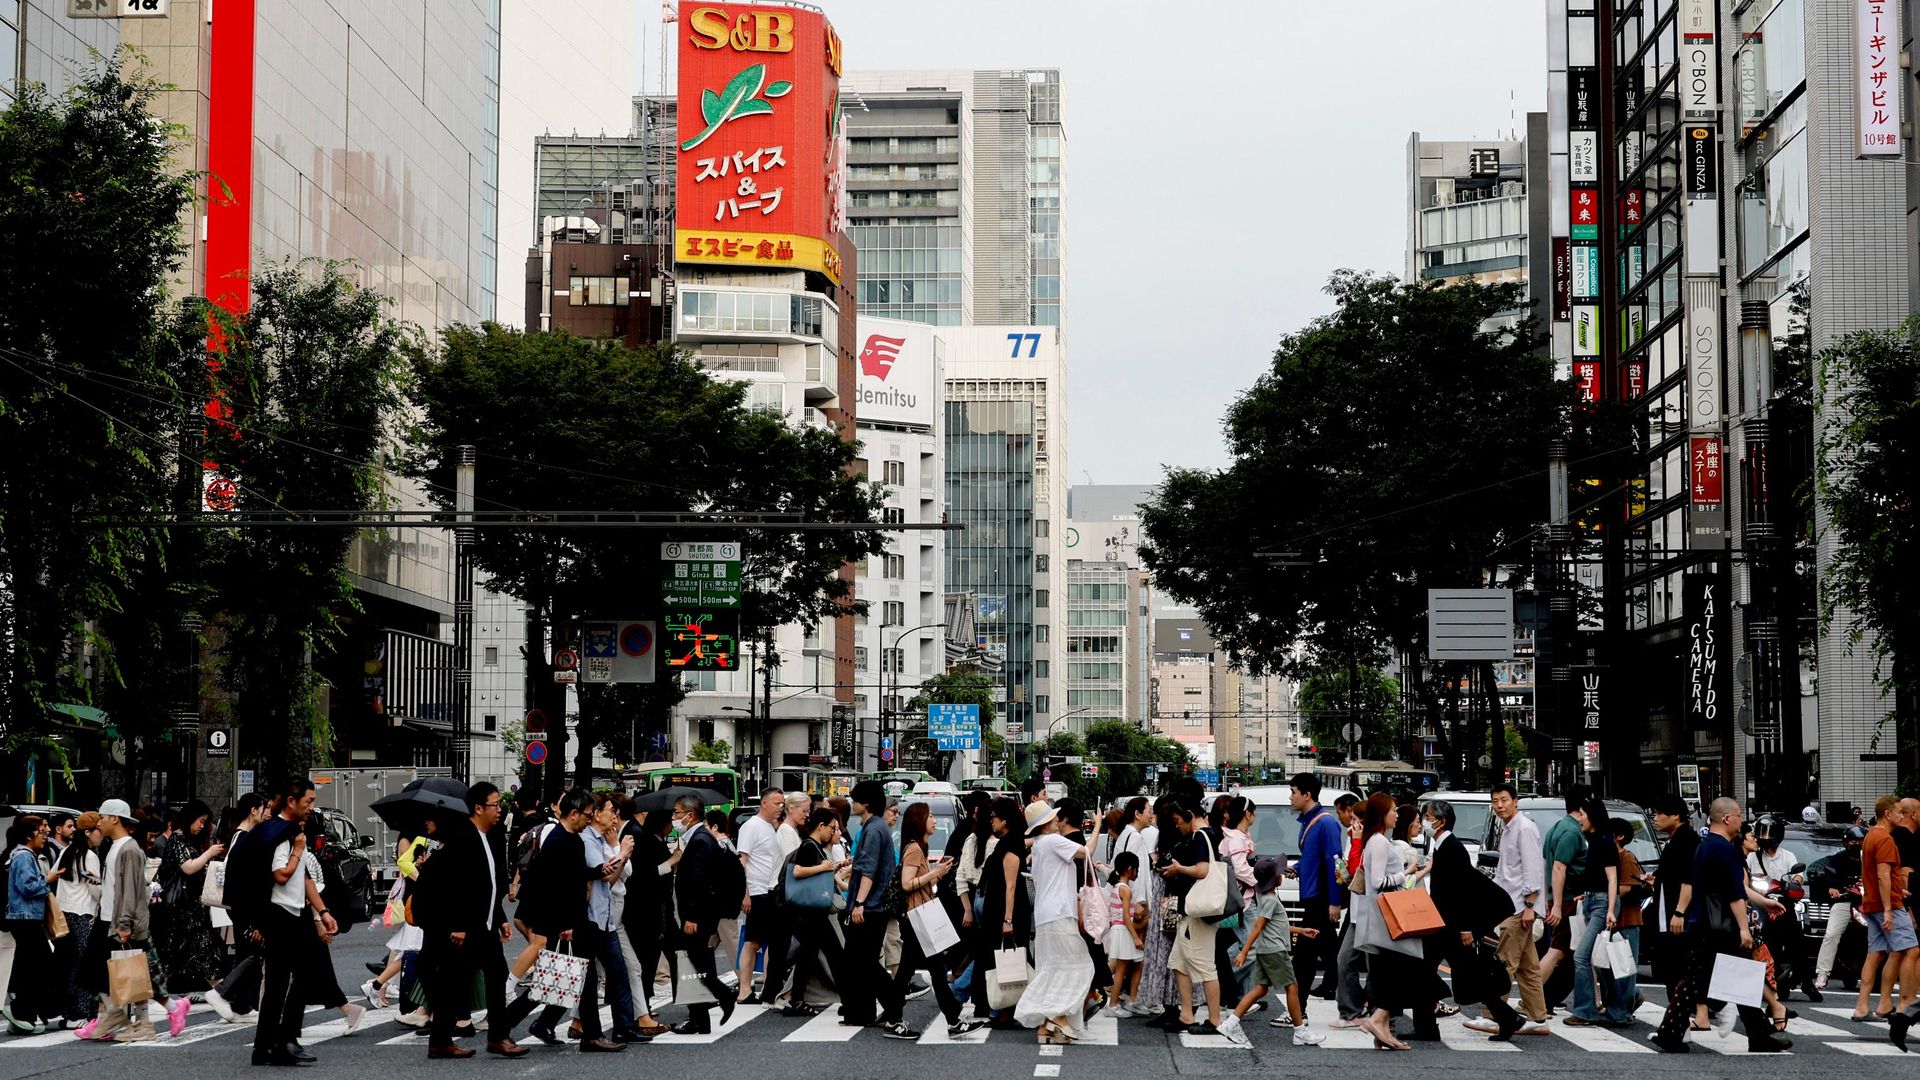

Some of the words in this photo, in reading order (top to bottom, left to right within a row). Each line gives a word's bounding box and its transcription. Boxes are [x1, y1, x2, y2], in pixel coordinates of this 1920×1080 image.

[690, 7, 795, 53] S&B
[1692, 0, 1702, 28] 小町
[1692, 50, 1706, 105] C'BON
[1577, 91, 1588, 121] 山形屋
[1583, 137, 1593, 175] カツミ堂
[1864, 134, 1896, 146] 10号館
[695, 145, 787, 183] スパイス
[1574, 145, 1582, 176] 写真機店
[1695, 156, 1706, 191] GINZA
[737, 176, 757, 196] &
[714, 187, 784, 221] ハーブ
[686, 237, 794, 261] エスビー食品
[1590, 249, 1597, 258] Le
[1577, 247, 1585, 295] 銀座コクリコ
[1589, 259, 1597, 296] Coquelicot
[1007, 333, 1041, 358] 77
[1696, 326, 1714, 416] SONOKO
[1695, 450, 1705, 496] ステーキ
[1705, 442, 1718, 478] 銀座の
[1698, 504, 1717, 512] B1F
[688, 544, 714, 553] 首都高
[691, 563, 710, 572] 銀座
[702, 596, 722, 604] 500m
[1690, 623, 1702, 713] CAMERA
[1703, 584, 1716, 720] KATSUMIDO
[1582, 673, 1600, 730] 山形屋
